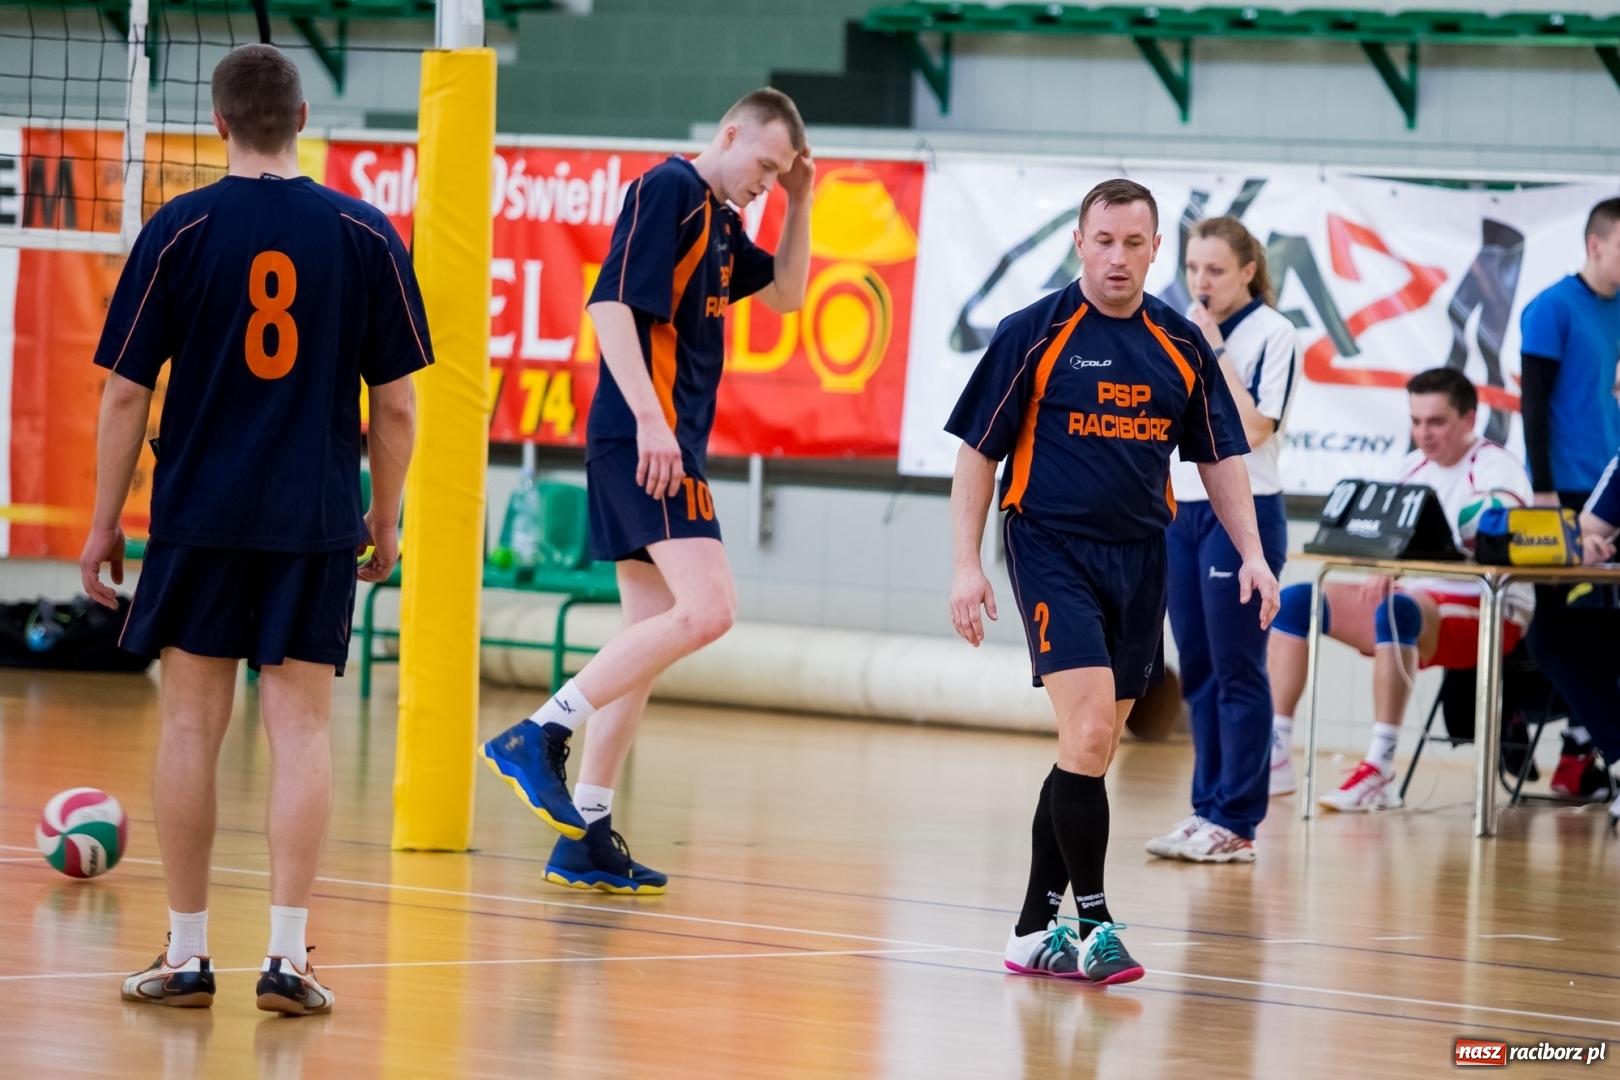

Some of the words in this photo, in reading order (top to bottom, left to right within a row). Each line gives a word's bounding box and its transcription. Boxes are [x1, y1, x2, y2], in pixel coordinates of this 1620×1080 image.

[350, 147, 418, 217] Sal
[245, 251, 298, 380] 8
[1081, 360, 1112, 368] COLO
[520, 368, 577, 436] 74
[1098, 381, 1151, 408] PSP
[1068, 411, 1172, 441] RACIBÓRZ
[682, 477, 714, 521] 10
[1381, 486, 1397, 514] 1
[1397, 490, 1425, 528] 11
[1034, 602, 1051, 653] 2
